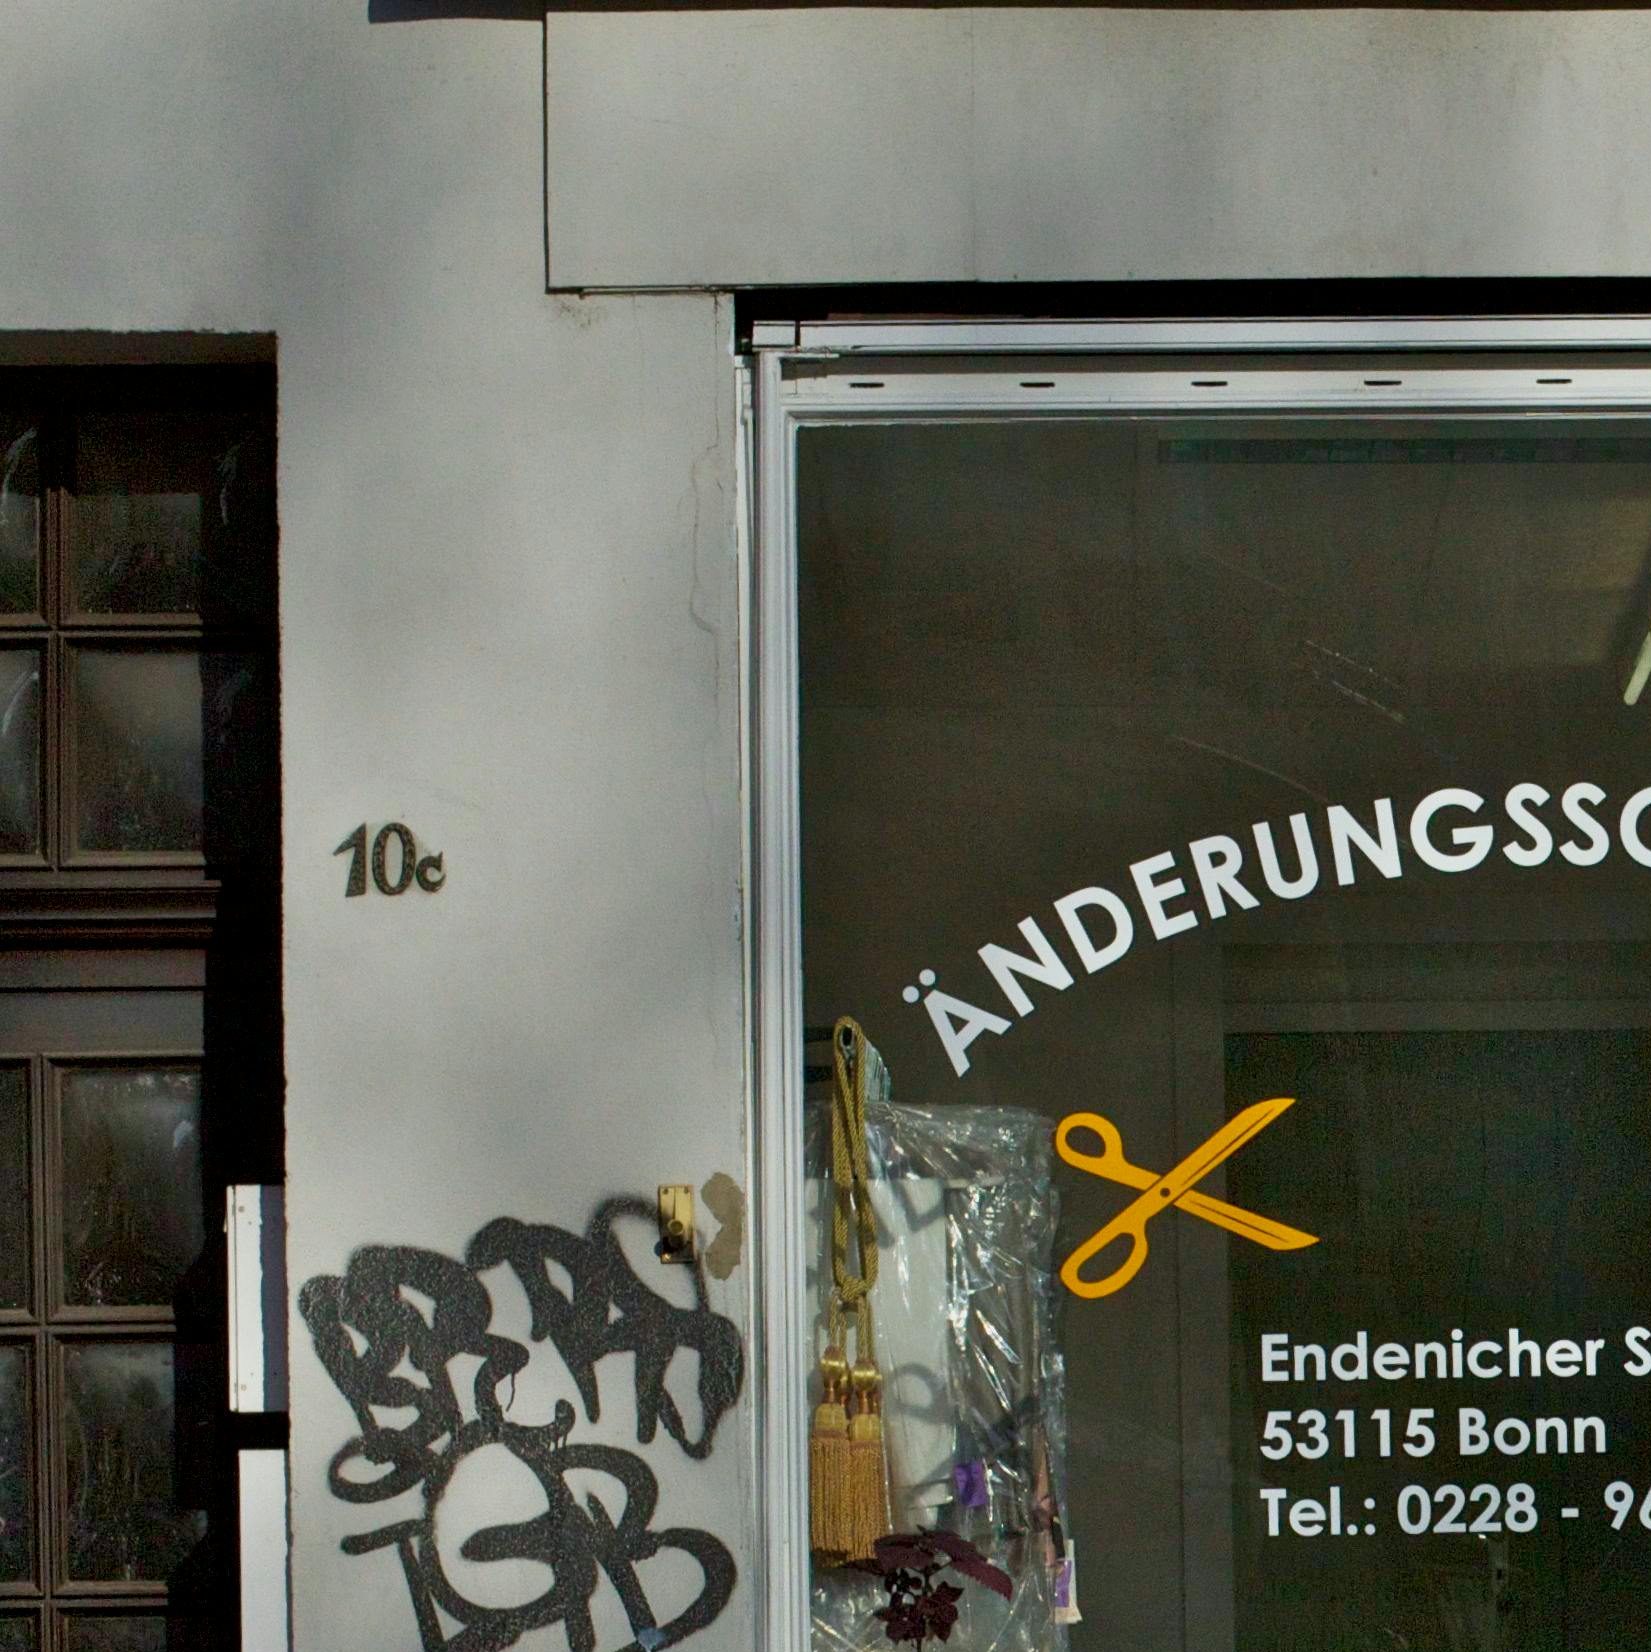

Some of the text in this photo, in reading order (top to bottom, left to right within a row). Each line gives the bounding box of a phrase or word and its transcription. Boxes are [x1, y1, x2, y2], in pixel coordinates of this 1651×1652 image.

[332, 821, 447, 898] 10c
[1260, 1326, 1606, 1383] Endenicher
[1259, 1406, 1607, 1461] 53115 Bonn
[1258, 1485, 1377, 1538] Tel.:
[1396, 1482, 1539, 1536] 0228
